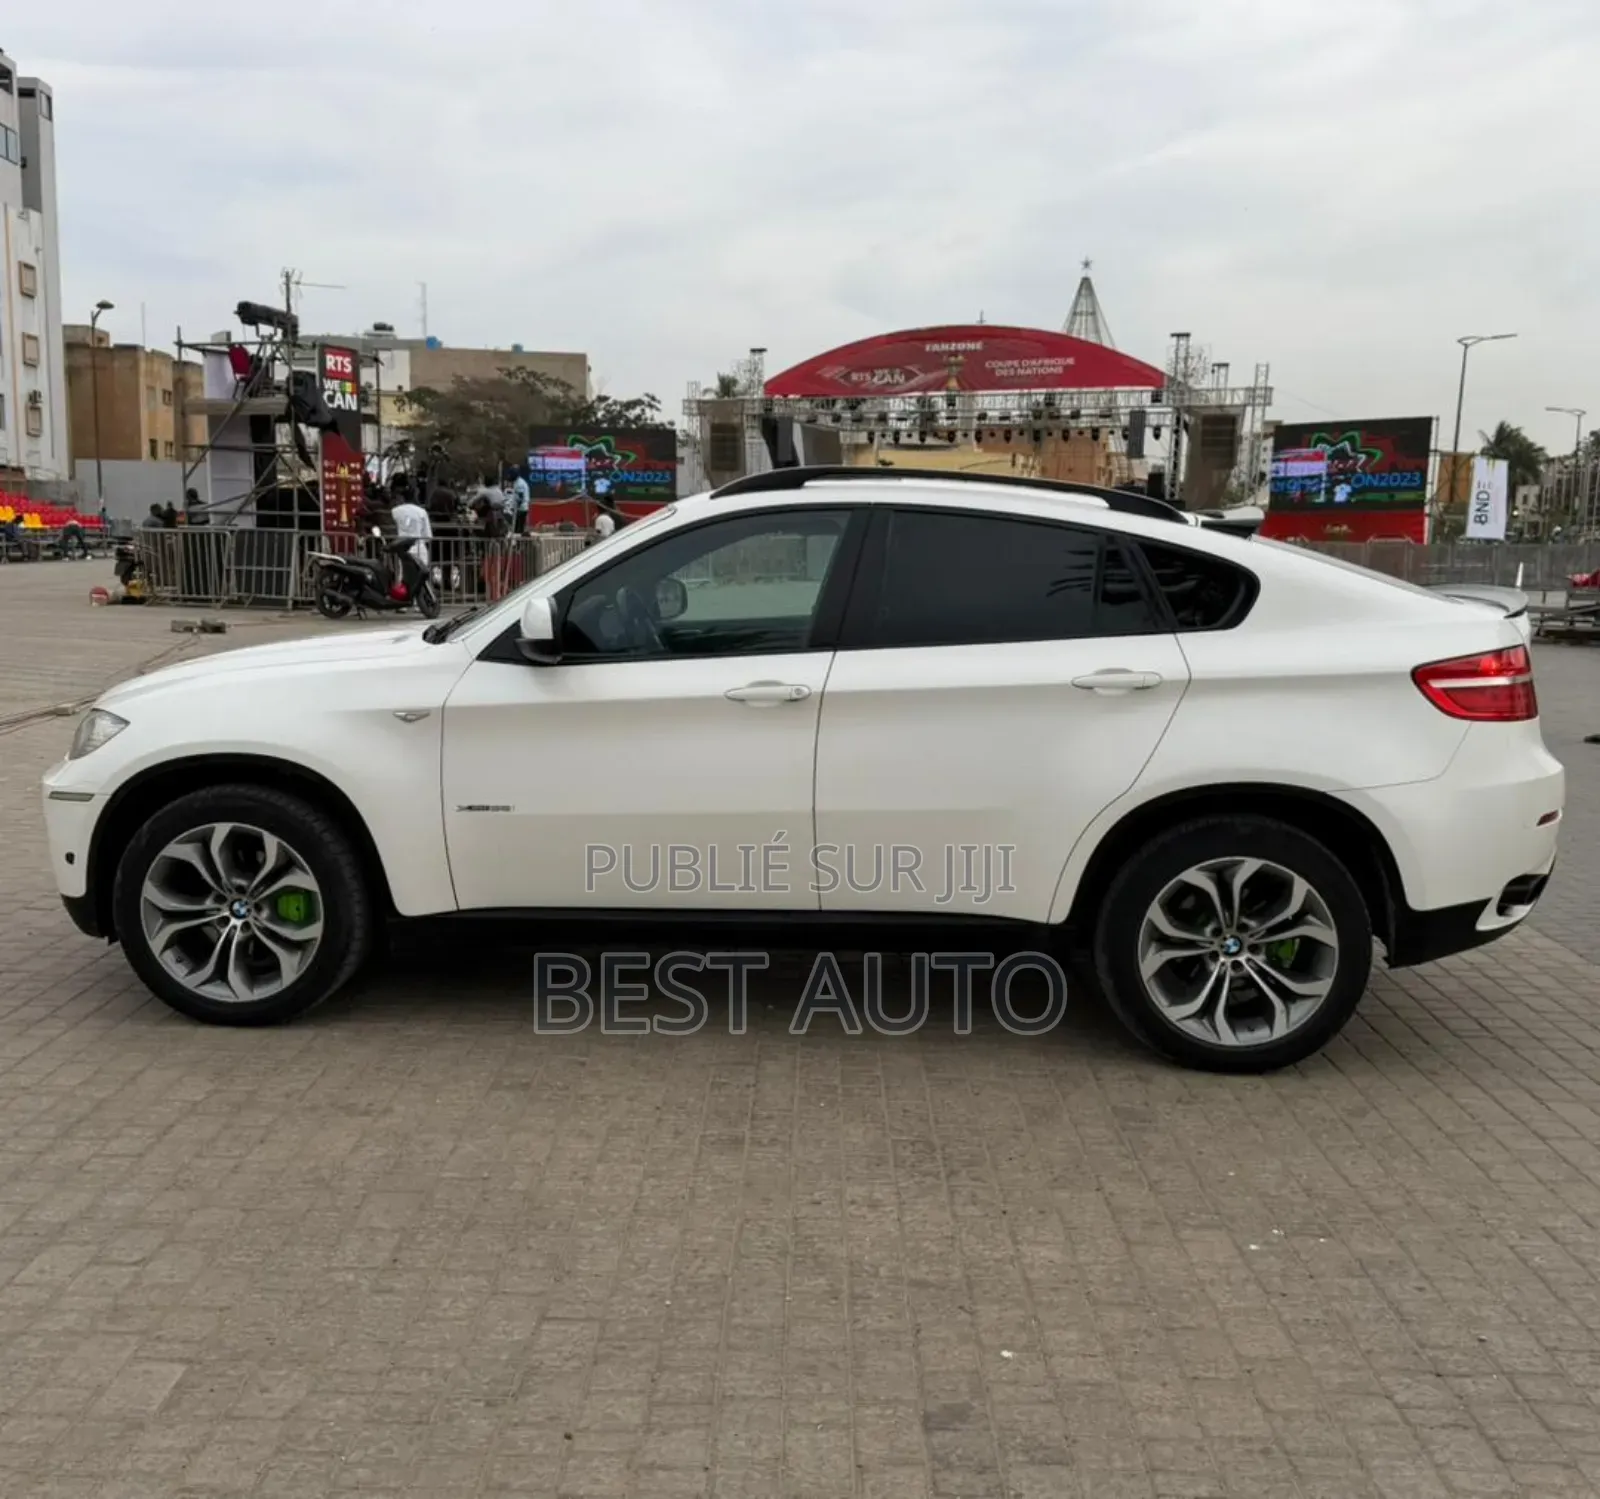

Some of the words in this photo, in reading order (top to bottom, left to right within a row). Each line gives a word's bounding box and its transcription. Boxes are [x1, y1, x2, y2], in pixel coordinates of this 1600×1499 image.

[325, 354, 352, 374] RTS
[985, 359, 1019, 368] COUPE
[995, 367, 1016, 377] DES
[1017, 366, 1063, 376] NATIONS
[323, 378, 341, 391] WE
[323, 390, 358, 411] CAN
